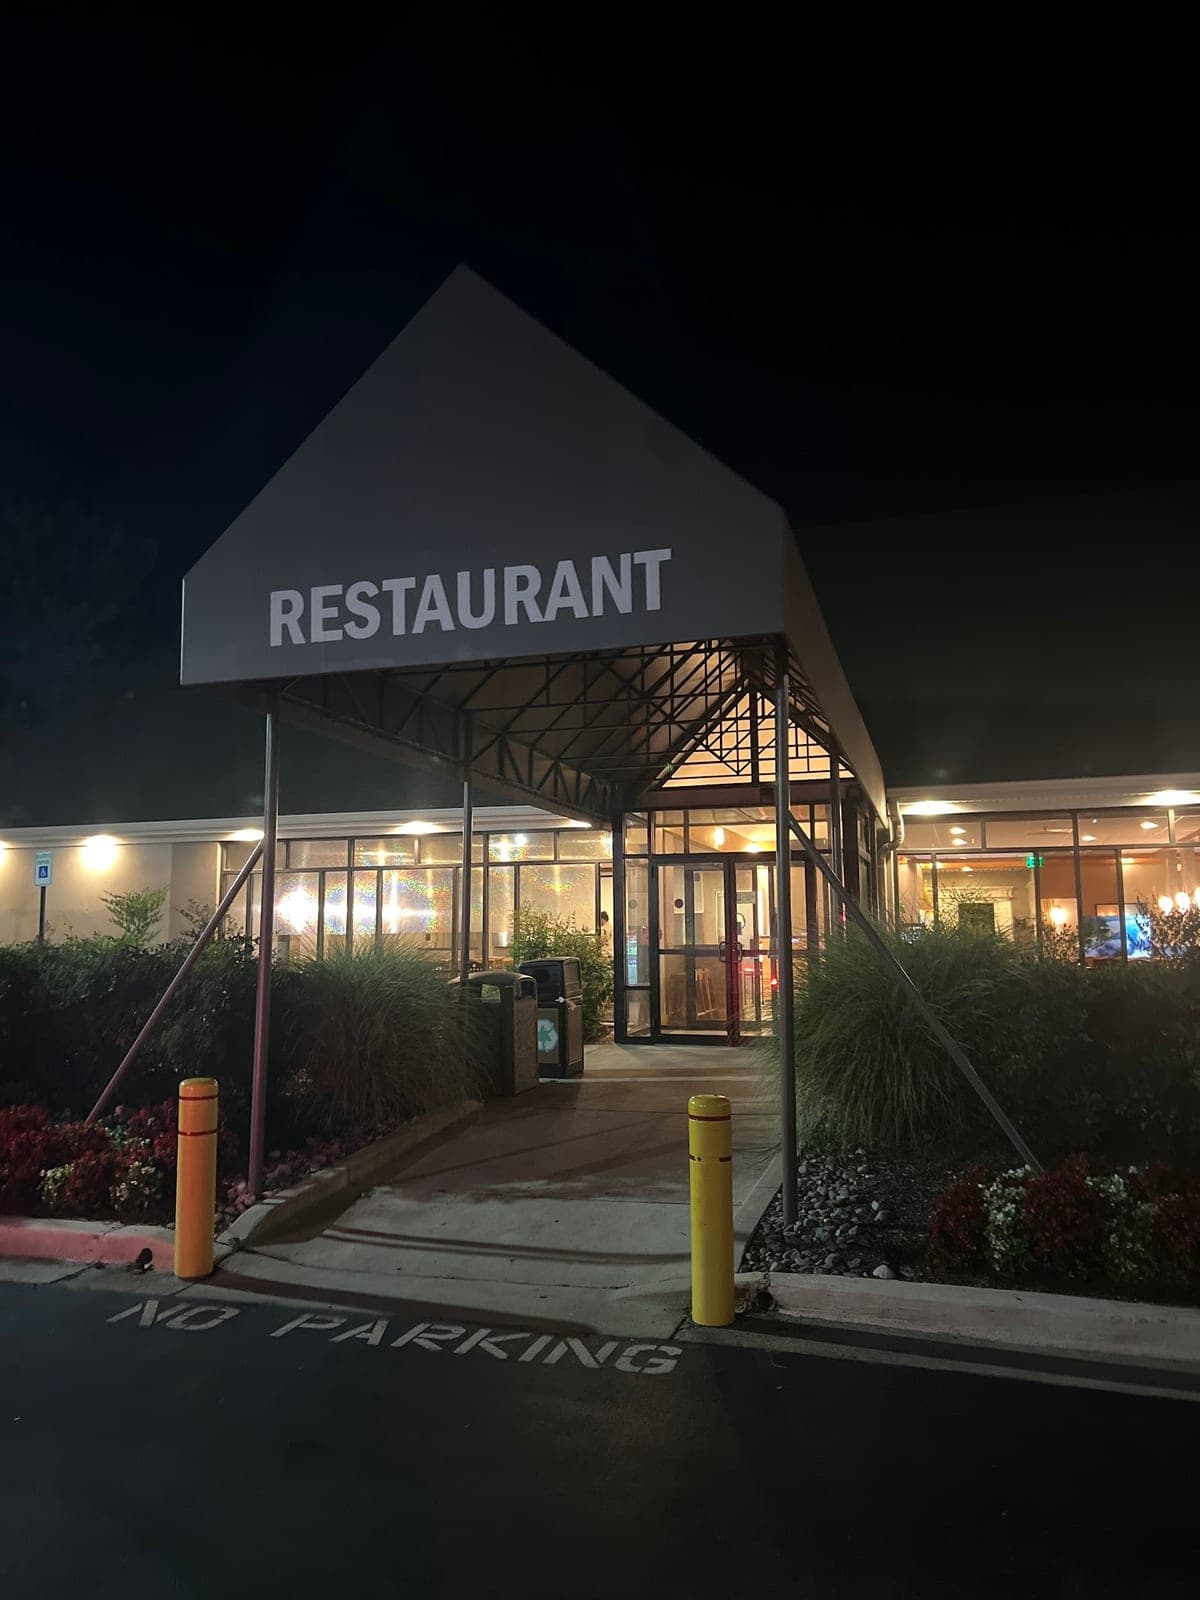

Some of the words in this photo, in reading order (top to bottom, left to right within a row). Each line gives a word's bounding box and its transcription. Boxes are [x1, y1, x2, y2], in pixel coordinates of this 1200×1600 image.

[270, 549, 671, 647] RESTAURANT
[106, 1299, 240, 1331] NO
[270, 1312, 683, 1374] PARKING
